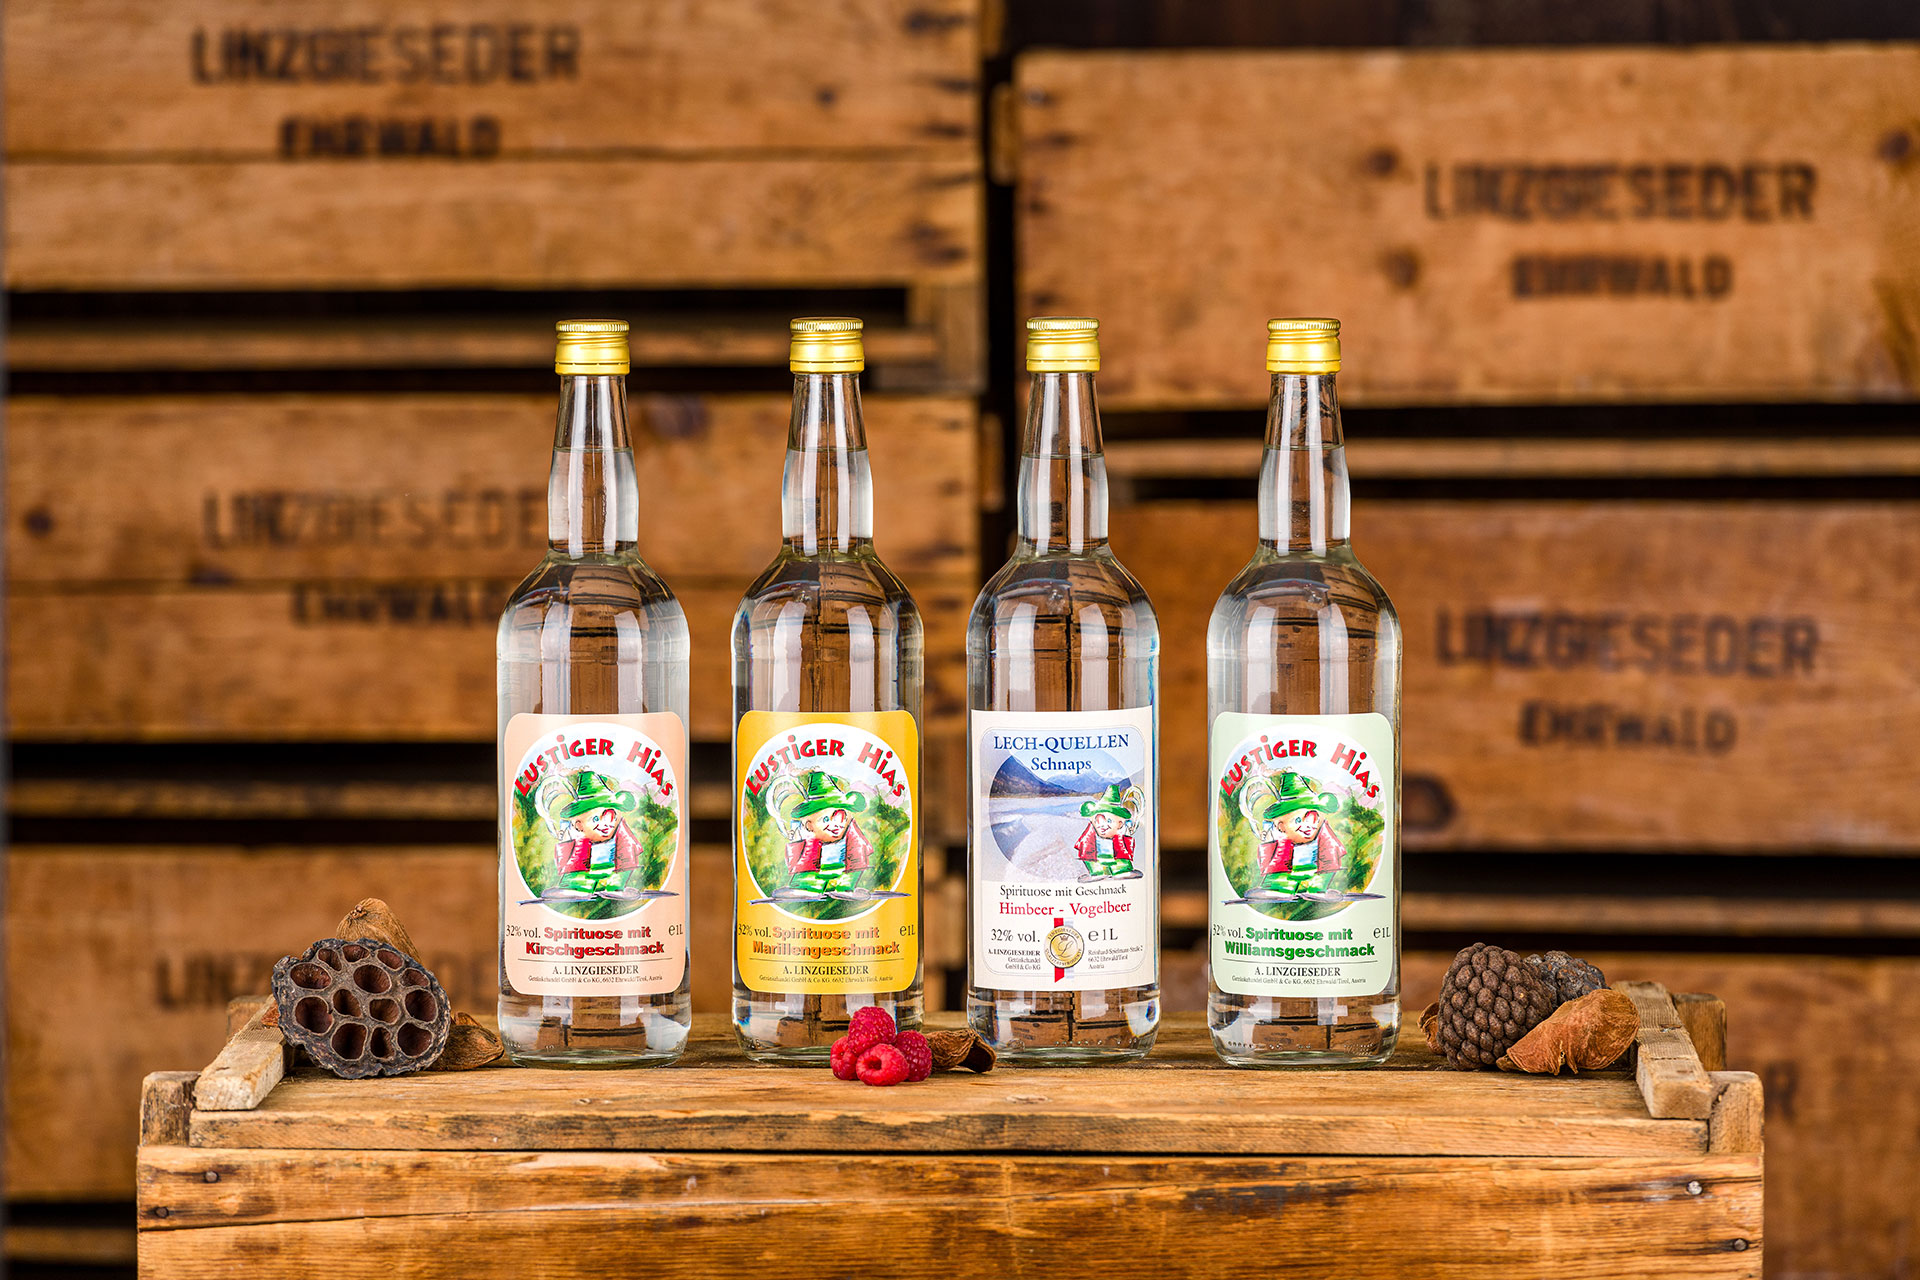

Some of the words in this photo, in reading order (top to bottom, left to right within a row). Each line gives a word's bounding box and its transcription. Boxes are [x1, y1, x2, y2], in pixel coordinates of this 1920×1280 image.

[994, 734, 1129, 753] LECH-QUELLEN
[1031, 757, 1092, 774] Schnaps
[1000, 885, 1052, 899] Spirituose
[1055, 886, 1072, 897] mit
[1075, 884, 1127, 896] Geschmack
[999, 902, 1054, 916] Himbeer
[1069, 901, 1131, 918] Vogelbeer
[523, 927, 541, 938] vol.
[544, 926, 623, 942] Spirituose
[627, 926, 651, 939] mit
[754, 927, 771, 938] vol.
[772, 926, 851, 941] Spirituose
[855, 926, 880, 939] mit
[991, 928, 1013, 942] 32%
[1018, 930, 1040, 943] vol.
[1228, 927, 1244, 938] vol.
[1245, 927, 1324, 942] Spirituose
[1328, 928, 1353, 940] mit
[526, 941, 664, 959] Kirschgeschmack
[752, 940, 900, 959] Marillengeschmack
[1224, 940, 1375, 960] Williamsgeschmack
[552, 966, 562, 975] A.
[564, 965, 639, 976] LINZGIESEDER
[783, 966, 792, 975] A.
[794, 965, 869, 976] LINZGIESEDER
[1254, 967, 1264, 976] A.
[1266, 966, 1341, 977] LINZGIESEDER
